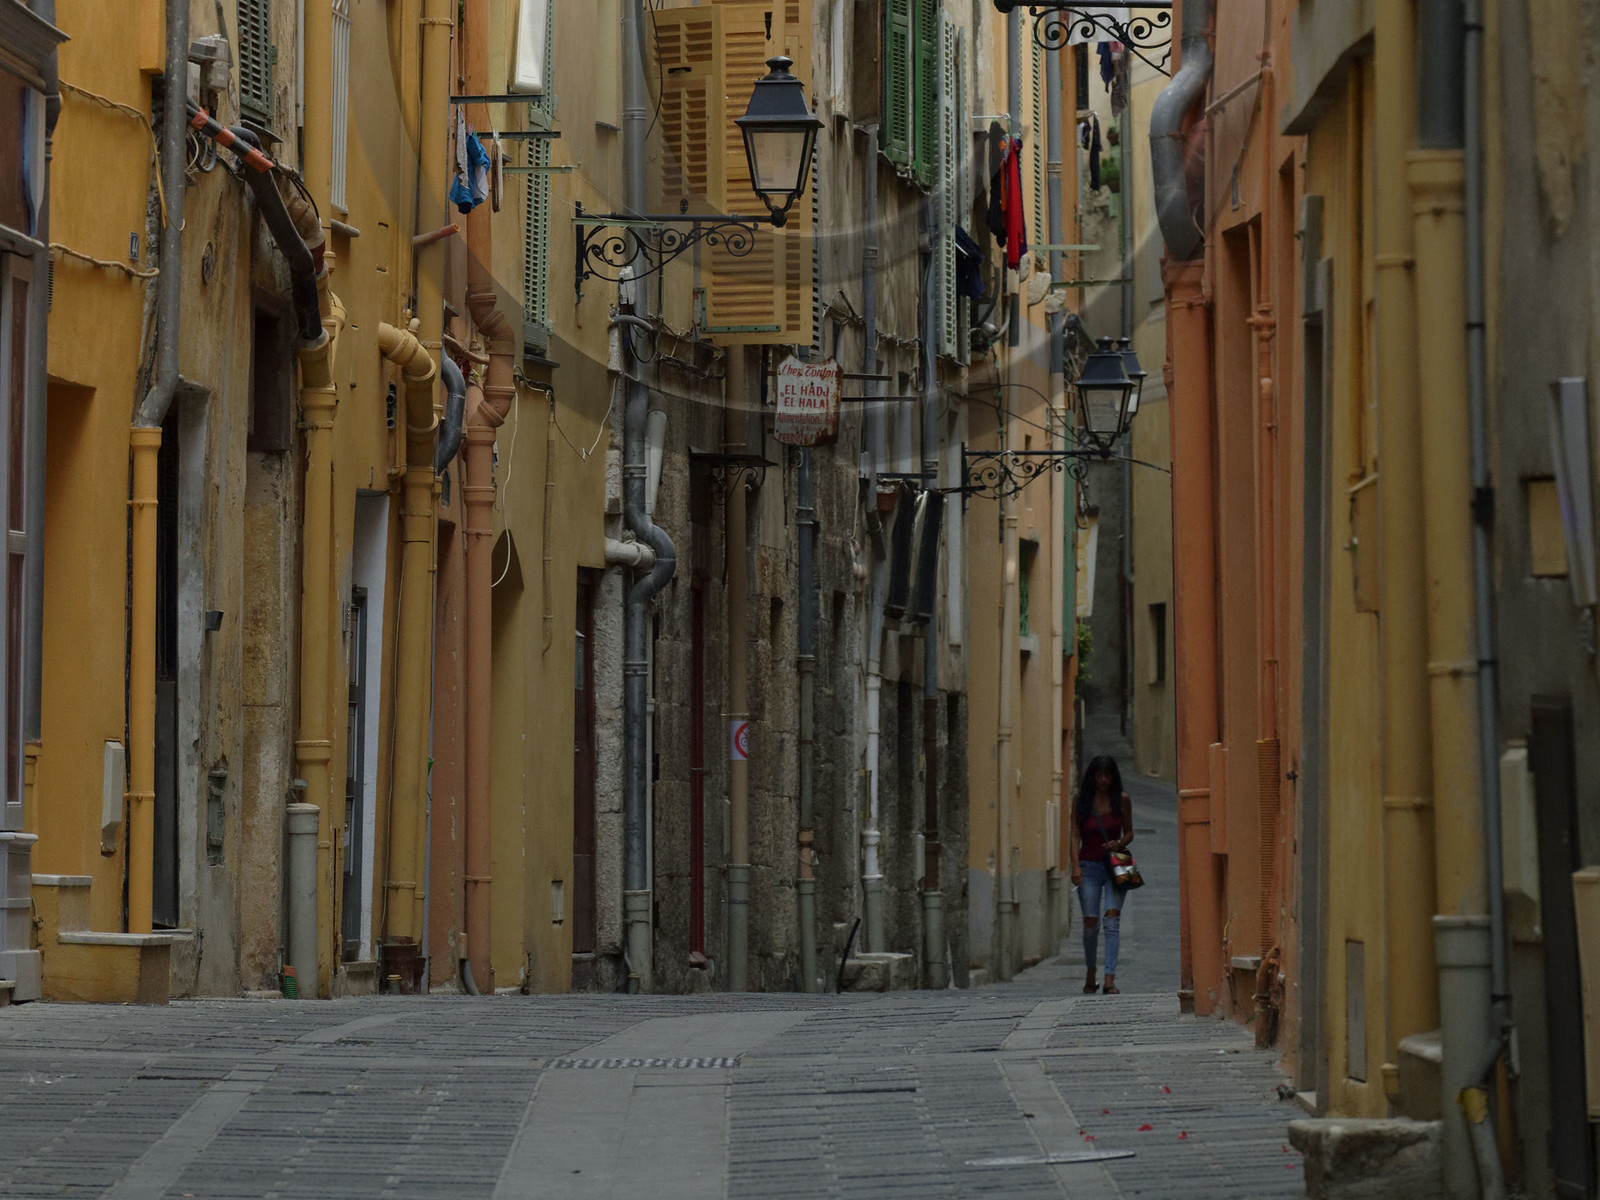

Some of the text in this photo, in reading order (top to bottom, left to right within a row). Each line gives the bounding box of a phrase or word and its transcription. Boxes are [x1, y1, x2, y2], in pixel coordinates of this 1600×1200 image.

[785, 385, 829, 397] EL HADJ
[784, 397, 796, 407] EL
